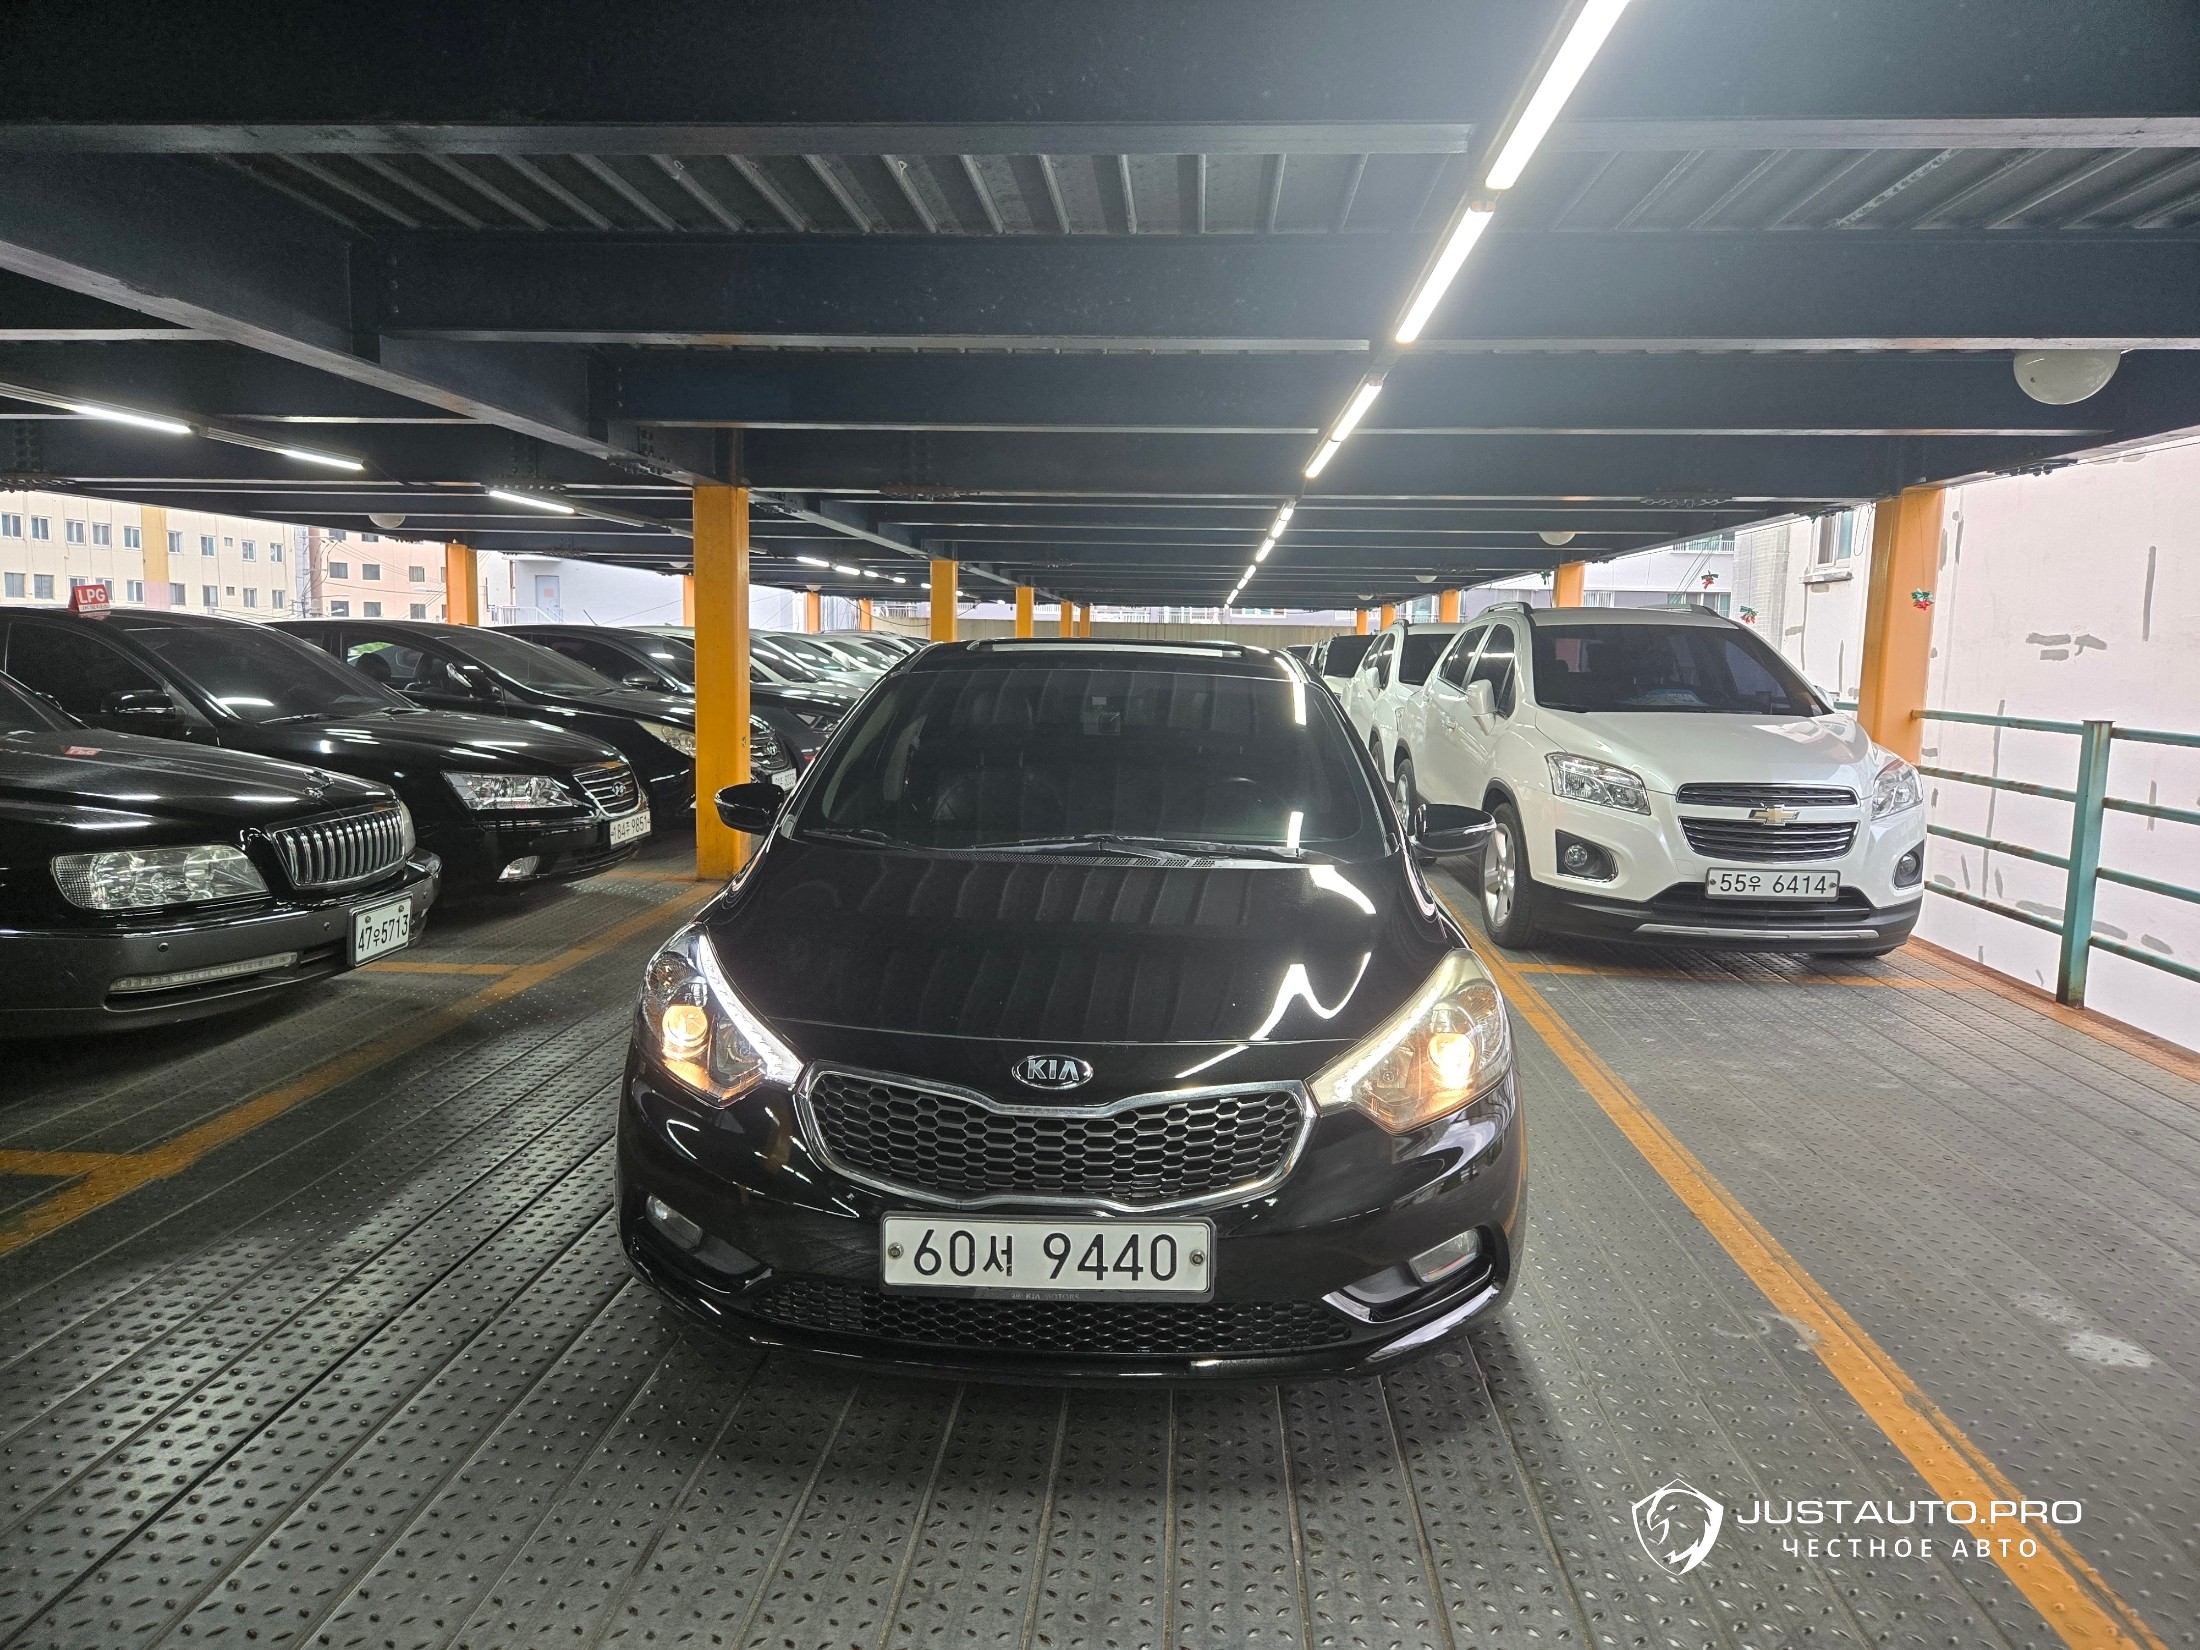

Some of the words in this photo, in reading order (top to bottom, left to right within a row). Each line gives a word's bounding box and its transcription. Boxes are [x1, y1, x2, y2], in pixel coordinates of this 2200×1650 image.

[77, 588, 106, 603] LPG
[632, 815, 648, 834] 9851
[1720, 873, 1761, 892] 55우
[1772, 875, 1827, 894] 6414
[358, 914, 409, 952] 47우5713
[1027, 1059, 1080, 1081] KIA
[913, 1229, 1013, 1277] 60서
[1043, 1232, 1178, 1281] 9440
[1025, 1292, 1040, 1300] KIA
